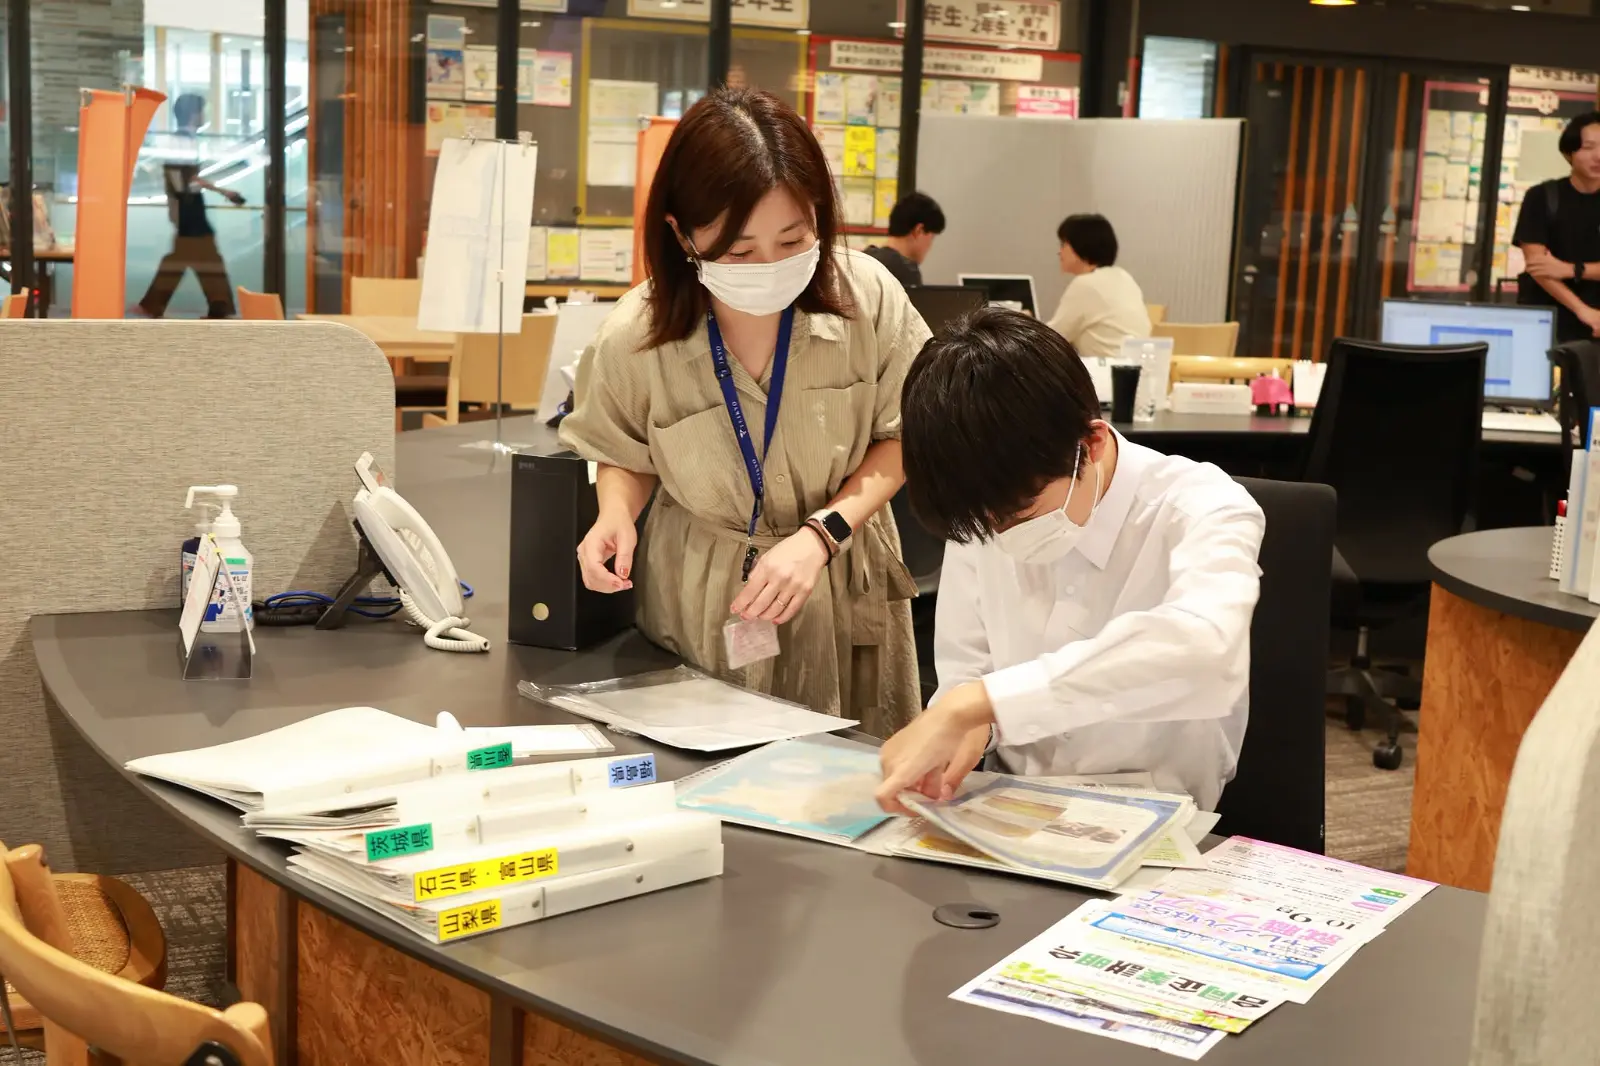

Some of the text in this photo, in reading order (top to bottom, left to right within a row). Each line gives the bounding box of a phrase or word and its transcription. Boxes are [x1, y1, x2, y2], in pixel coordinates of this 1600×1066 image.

[469, 747, 512, 769] 香川県
[611, 760, 654, 784] 福島県
[370, 828, 430, 857] 茨城県
[419, 852, 554, 897] 石川県・富山県
[442, 904, 498, 935] 山梨県
[1048, 945, 1269, 1009] 合同企業説明会
